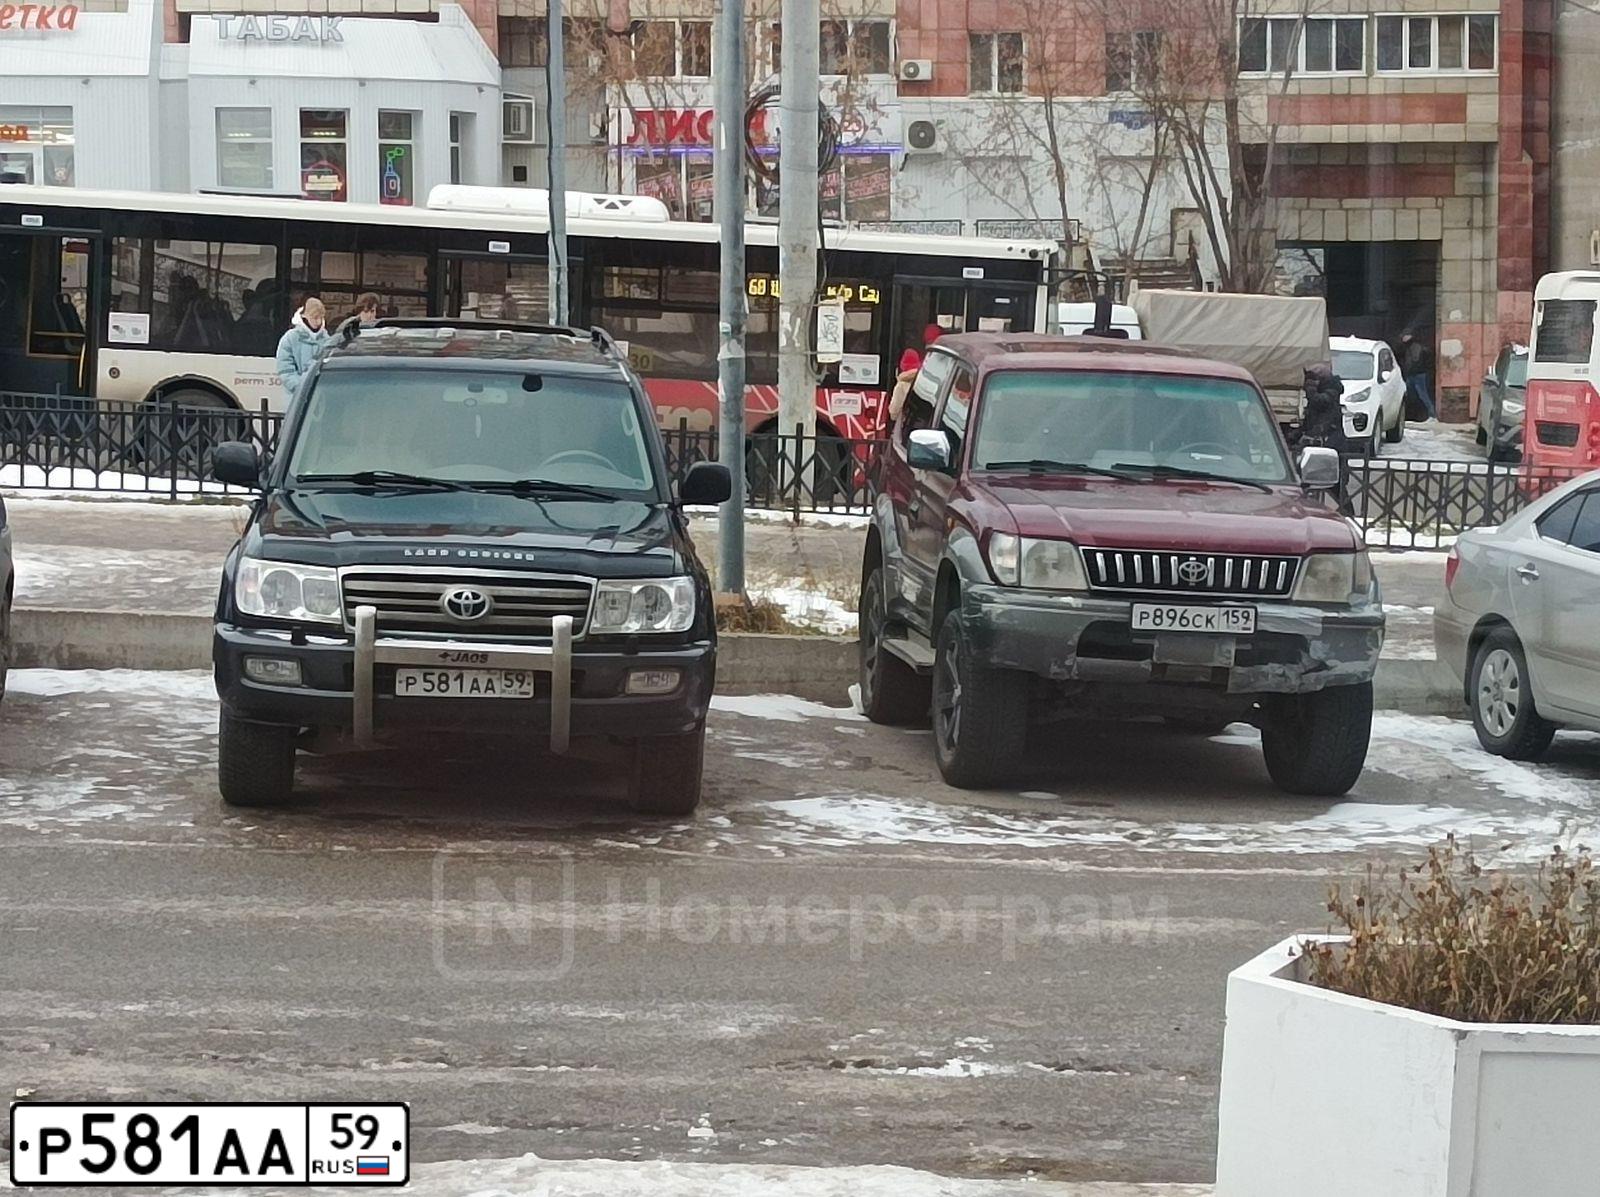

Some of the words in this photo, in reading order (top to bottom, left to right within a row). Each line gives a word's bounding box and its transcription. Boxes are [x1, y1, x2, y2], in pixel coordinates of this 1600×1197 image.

[0, 4, 79, 30] етка
[211, 13, 344, 41] ТАБАК
[234, 377, 265, 386] perm
[1139, 608, 1215, 629] Р896СК
[1222, 609, 1251, 625] 159
[450, 652, 489, 664] JAOS
[405, 672, 496, 694] Р581АА
[503, 671, 526, 689] 59
